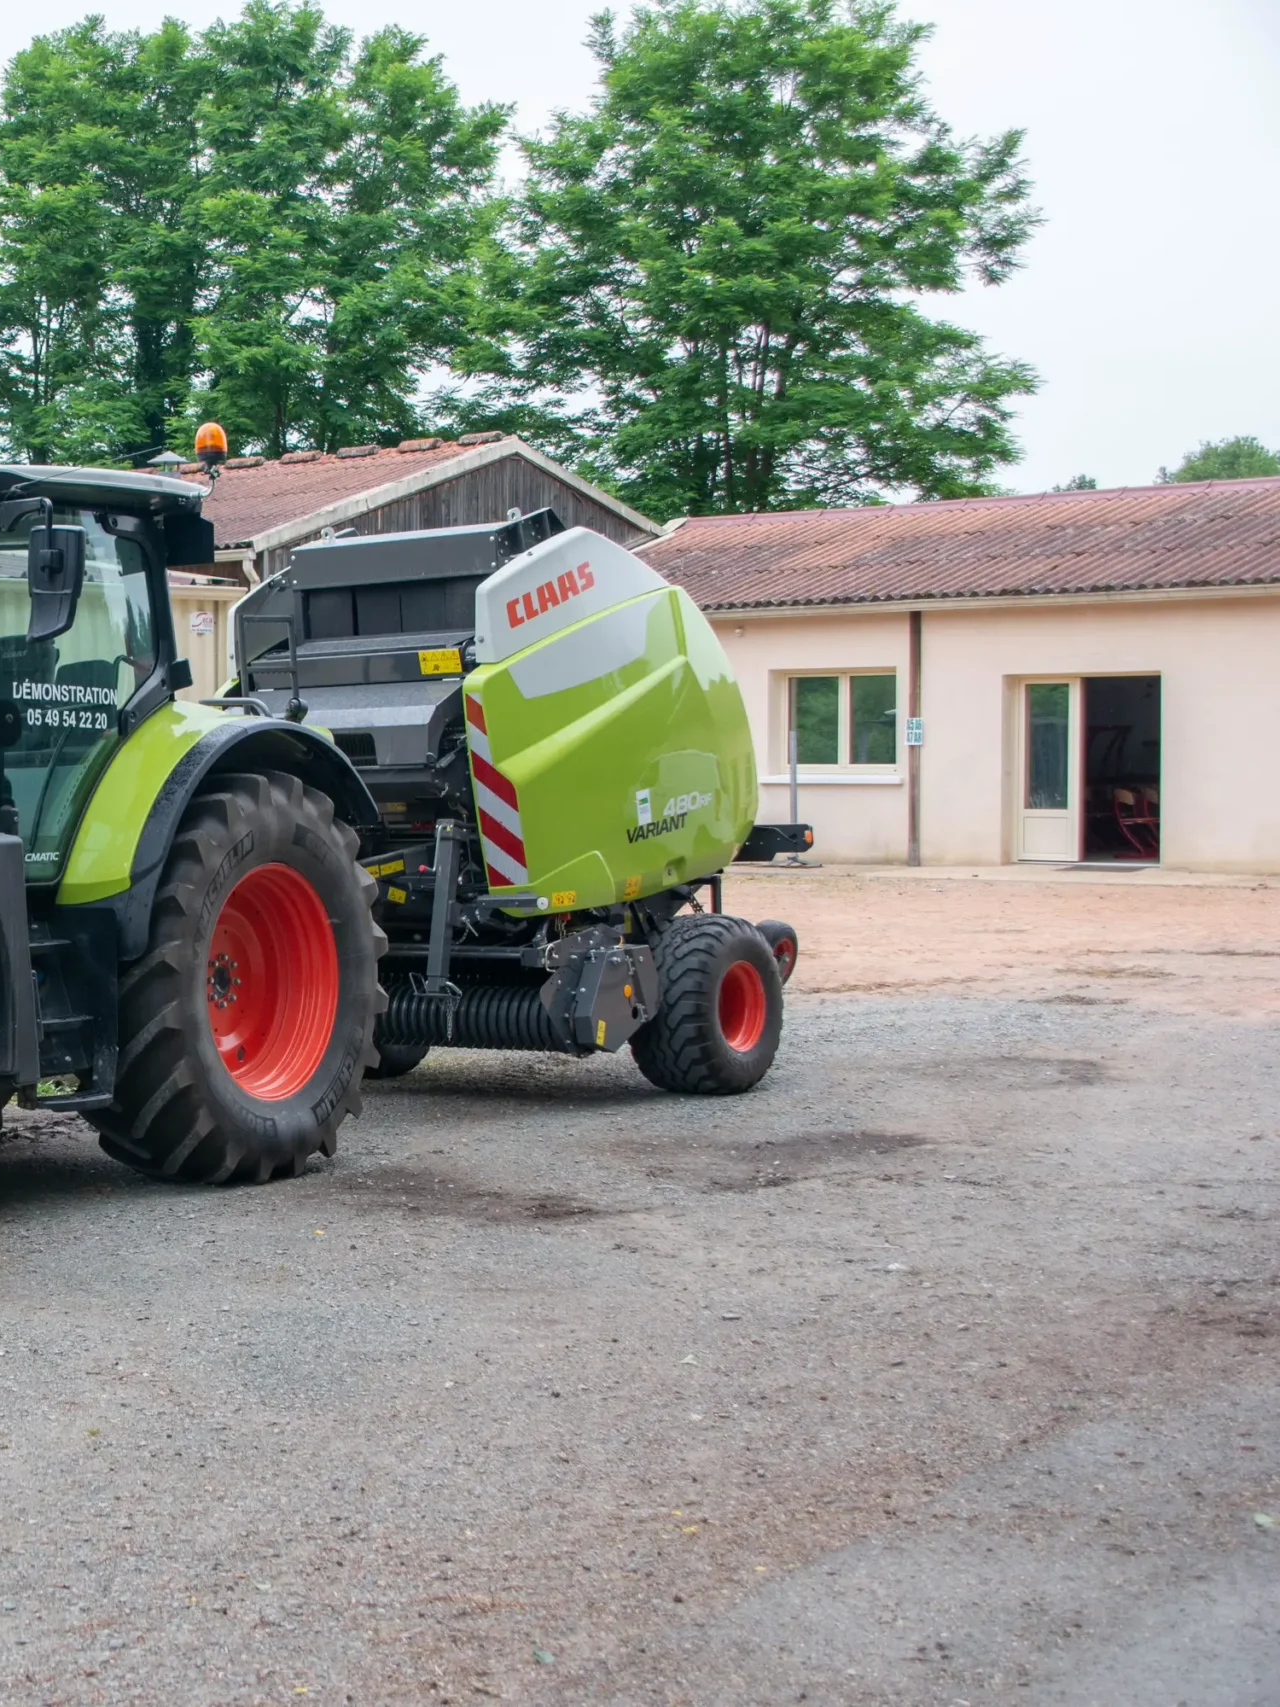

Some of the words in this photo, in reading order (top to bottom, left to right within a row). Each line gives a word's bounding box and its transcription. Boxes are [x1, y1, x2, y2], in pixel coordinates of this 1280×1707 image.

[505, 561, 595, 629] CLAAS
[12, 679, 118, 705] DÉMONSTRATION
[27, 708, 42, 725] 05
[45, 710, 60, 726] 49
[62, 711, 76, 727] 54
[79, 712, 92, 729] 22
[95, 713, 108, 729] 20
[626, 812, 688, 844] VARIANT
[24, 851, 60, 862] CMATIC
